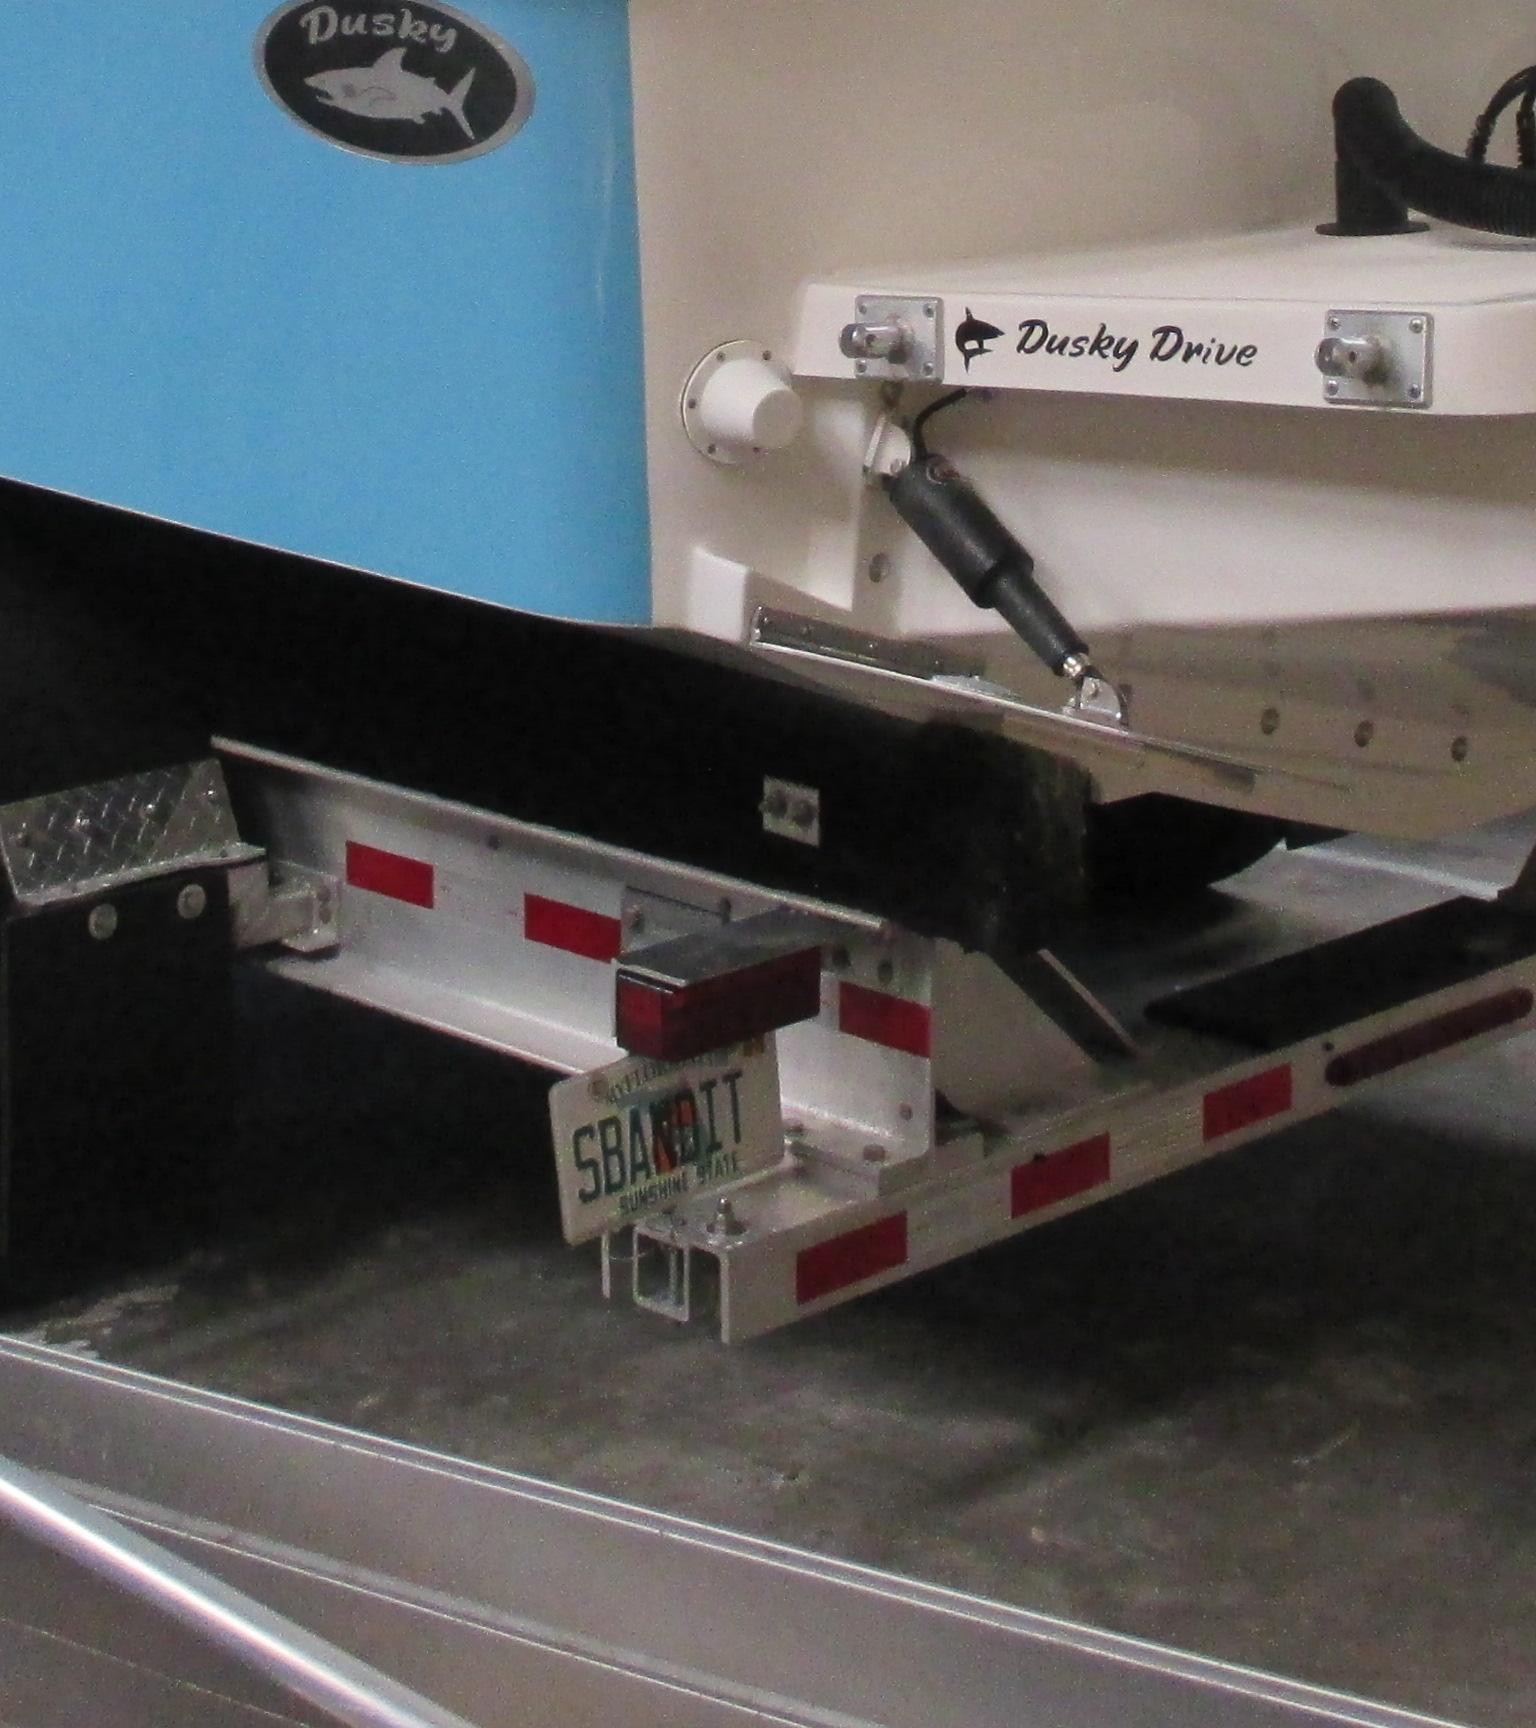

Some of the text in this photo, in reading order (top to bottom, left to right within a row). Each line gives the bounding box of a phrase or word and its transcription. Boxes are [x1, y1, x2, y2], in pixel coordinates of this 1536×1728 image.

[299, 5, 458, 54] Dusky
[1016, 318, 1259, 373] Dusky Drive
[572, 1068, 743, 1205] SBANDIT
